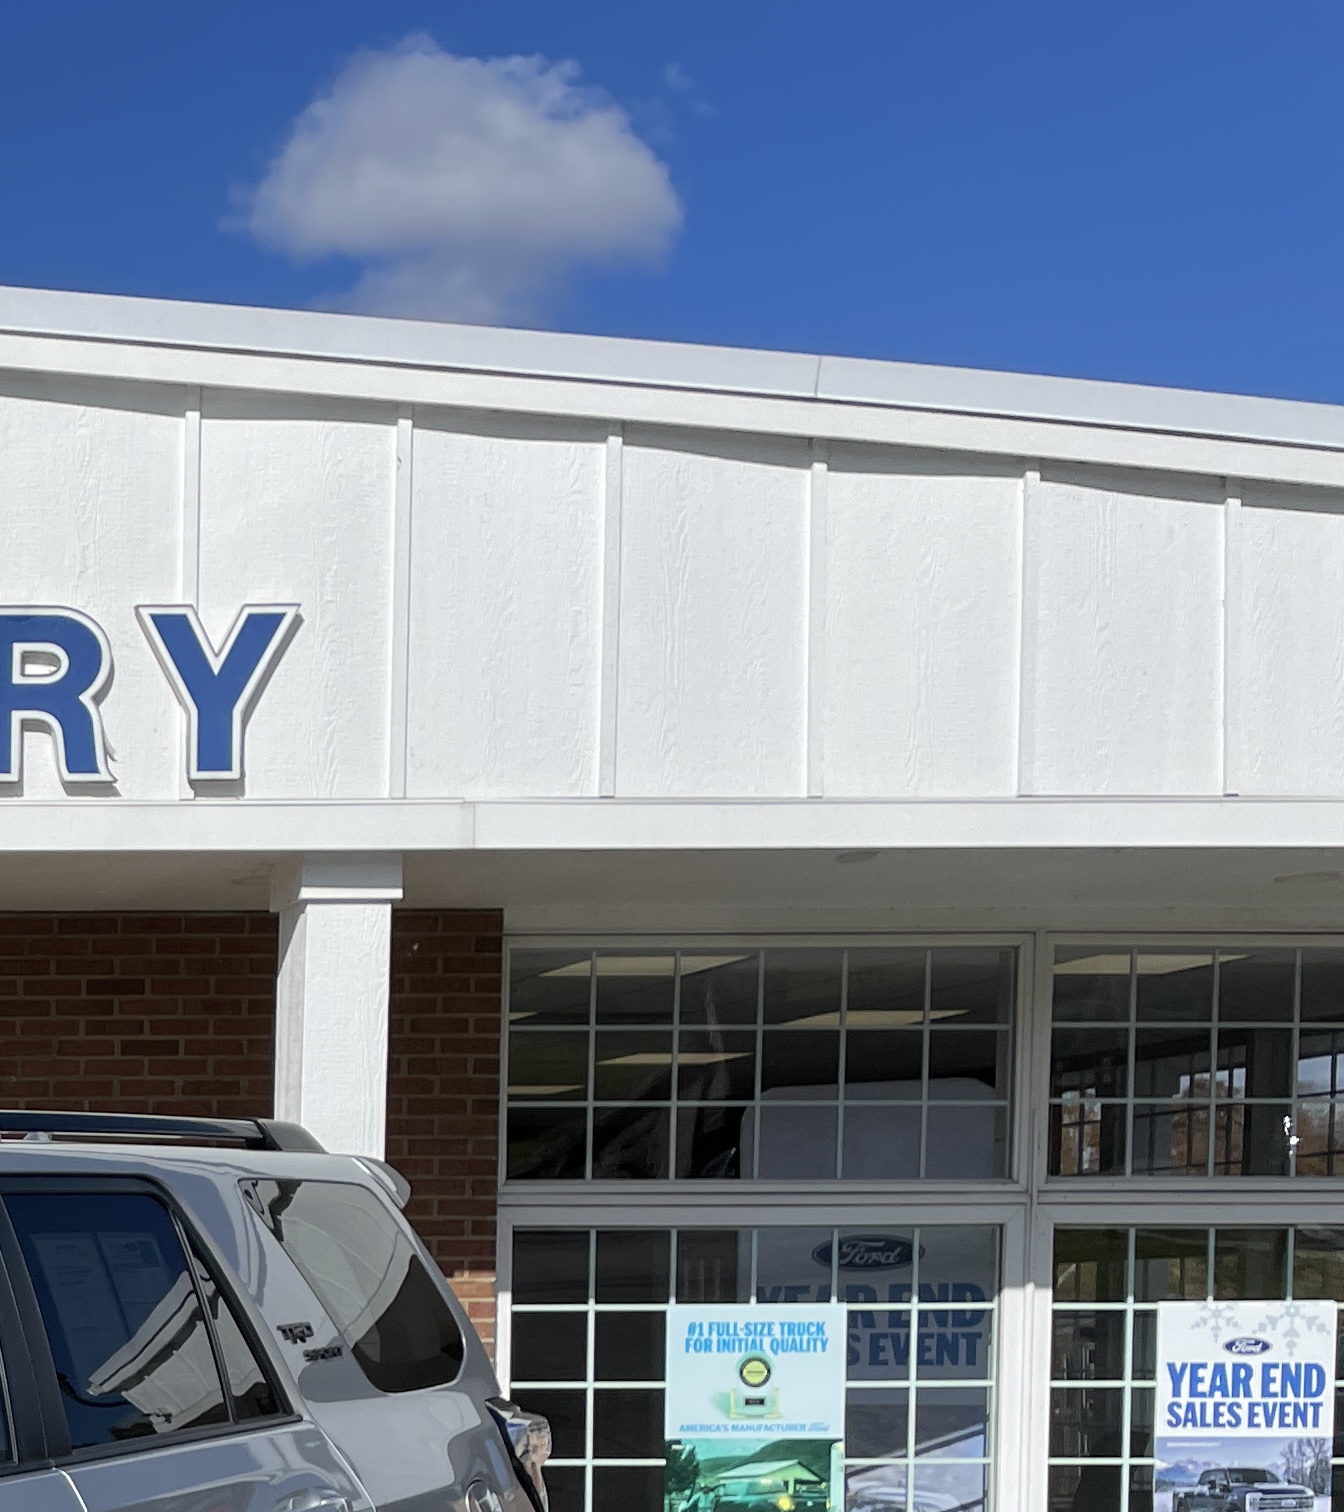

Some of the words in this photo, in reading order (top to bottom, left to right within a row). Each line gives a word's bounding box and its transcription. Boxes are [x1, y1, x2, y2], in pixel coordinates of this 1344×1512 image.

[839, 1241, 903, 1265] Ford
[687, 1322, 705, 1337] #1
[708, 1321, 776, 1337] FULL-SIZE
[779, 1321, 827, 1336] TRUCK
[685, 1338, 713, 1353] FOR
[716, 1338, 766, 1353] INITIAL
[770, 1337, 829, 1356] QUALITY
[1231, 1338, 1263, 1354] Ford
[1166, 1362, 1254, 1398] YEAR
[1260, 1362, 1326, 1398] END
[1166, 1401, 1242, 1428] SALES
[1248, 1401, 1324, 1428] EVENT
[731, 1423, 806, 1432] MANUFACTURER
